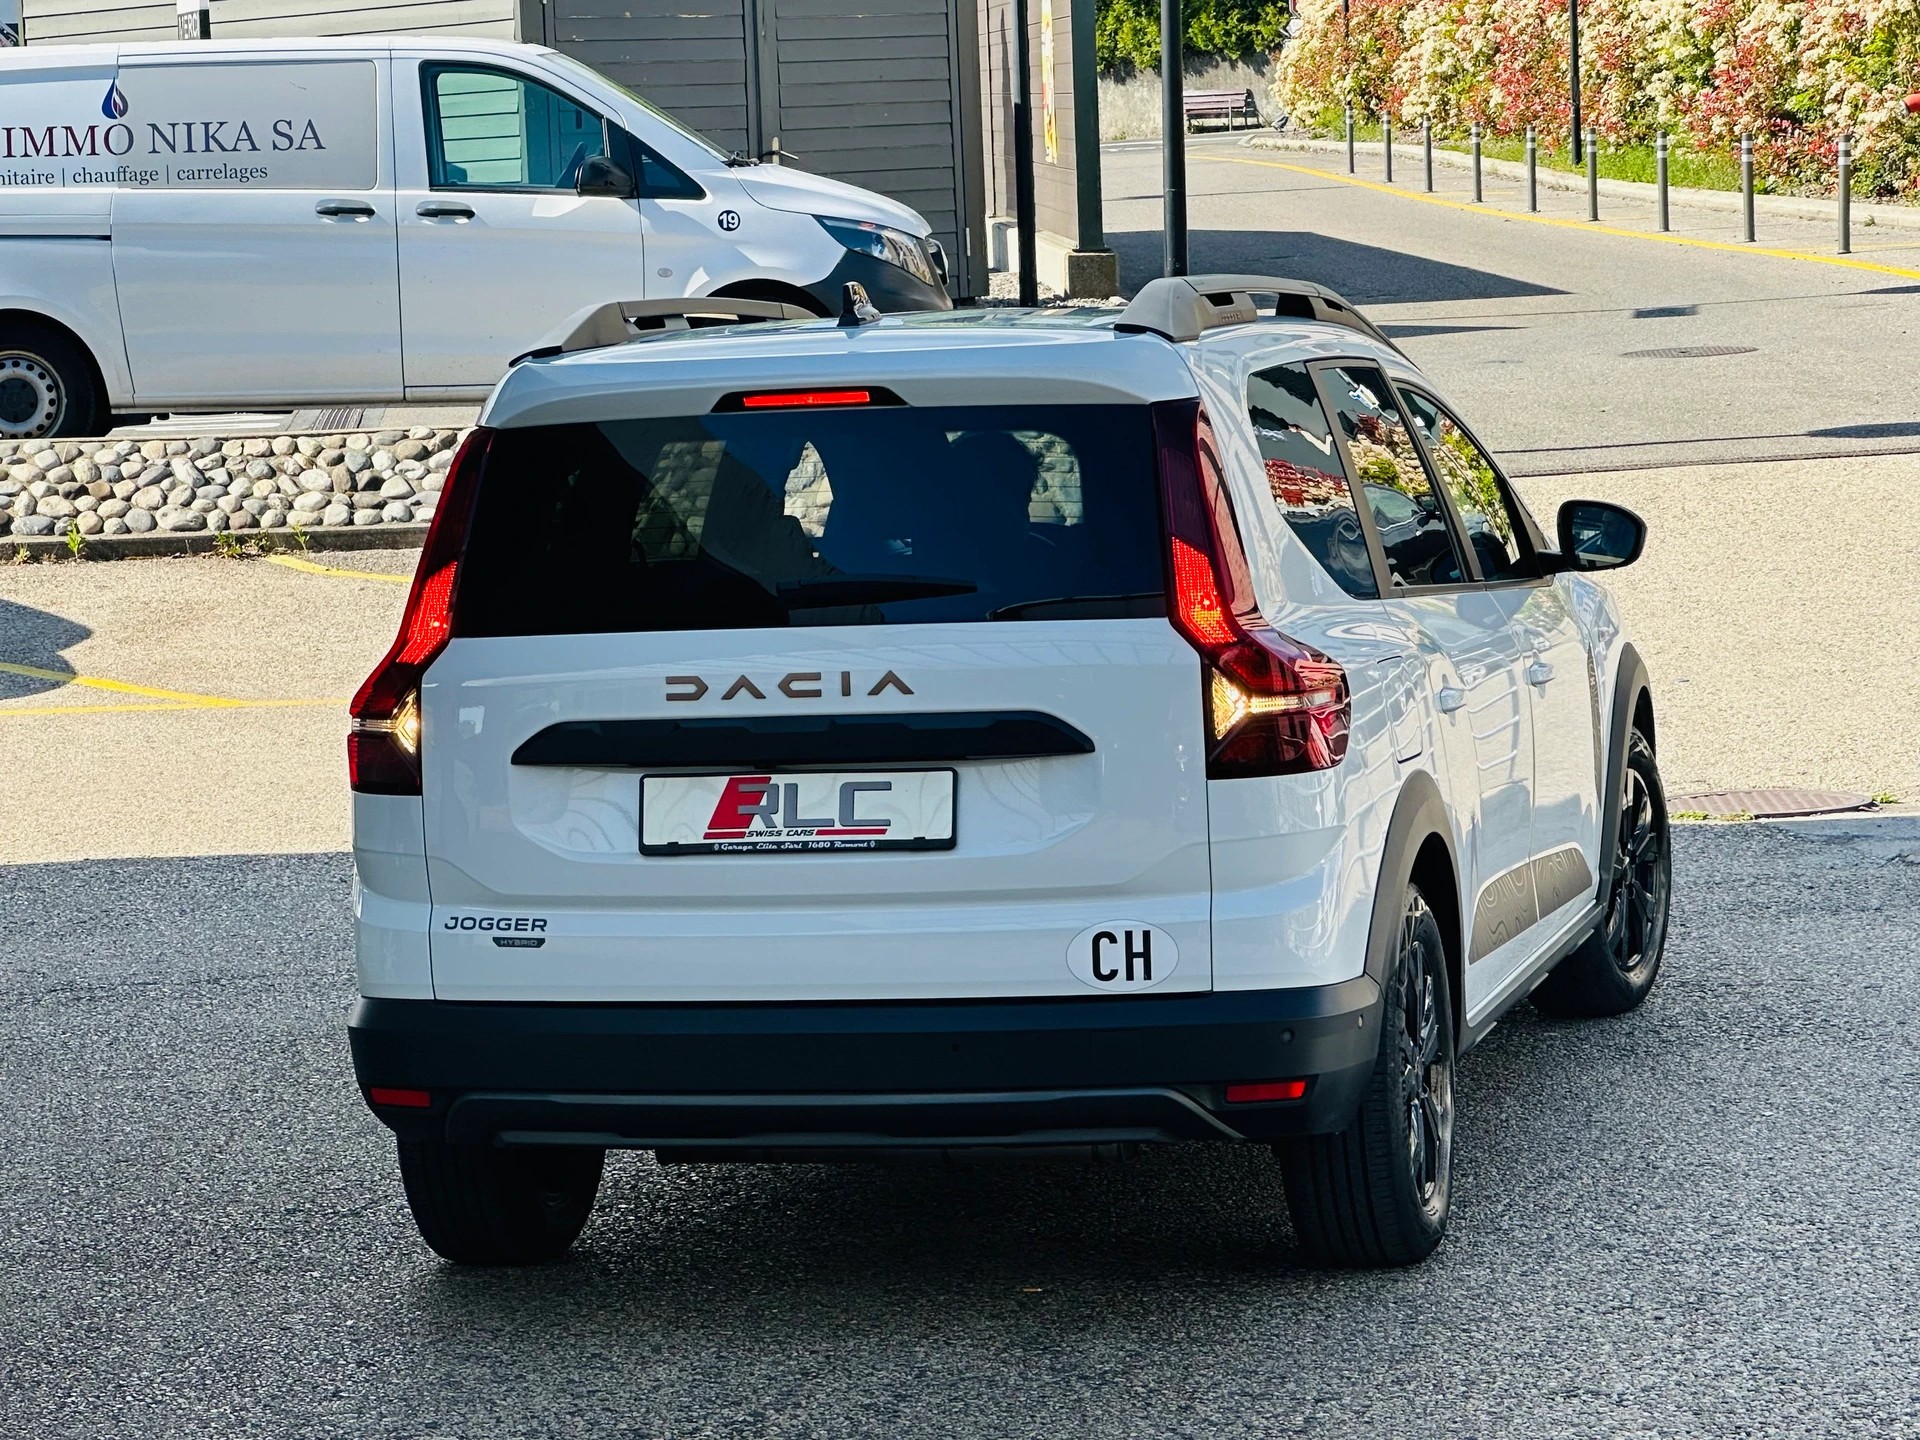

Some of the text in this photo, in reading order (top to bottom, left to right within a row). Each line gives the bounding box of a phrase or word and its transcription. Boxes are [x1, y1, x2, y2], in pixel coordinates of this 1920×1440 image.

[2, 119, 326, 158] IMMO NIKA SA
[72, 165, 159, 186] chauffage
[177, 163, 268, 183] carrelages
[719, 212, 739, 229] 19
[665, 670, 915, 702] DACIA
[747, 829, 816, 838] SWISS CARS
[721, 843, 753, 851] Garage
[808, 841, 831, 849] 1680
[444, 916, 548, 932] JOGGER
[500, 939, 538, 947] HYBRID
[1092, 930, 1152, 982] CH
